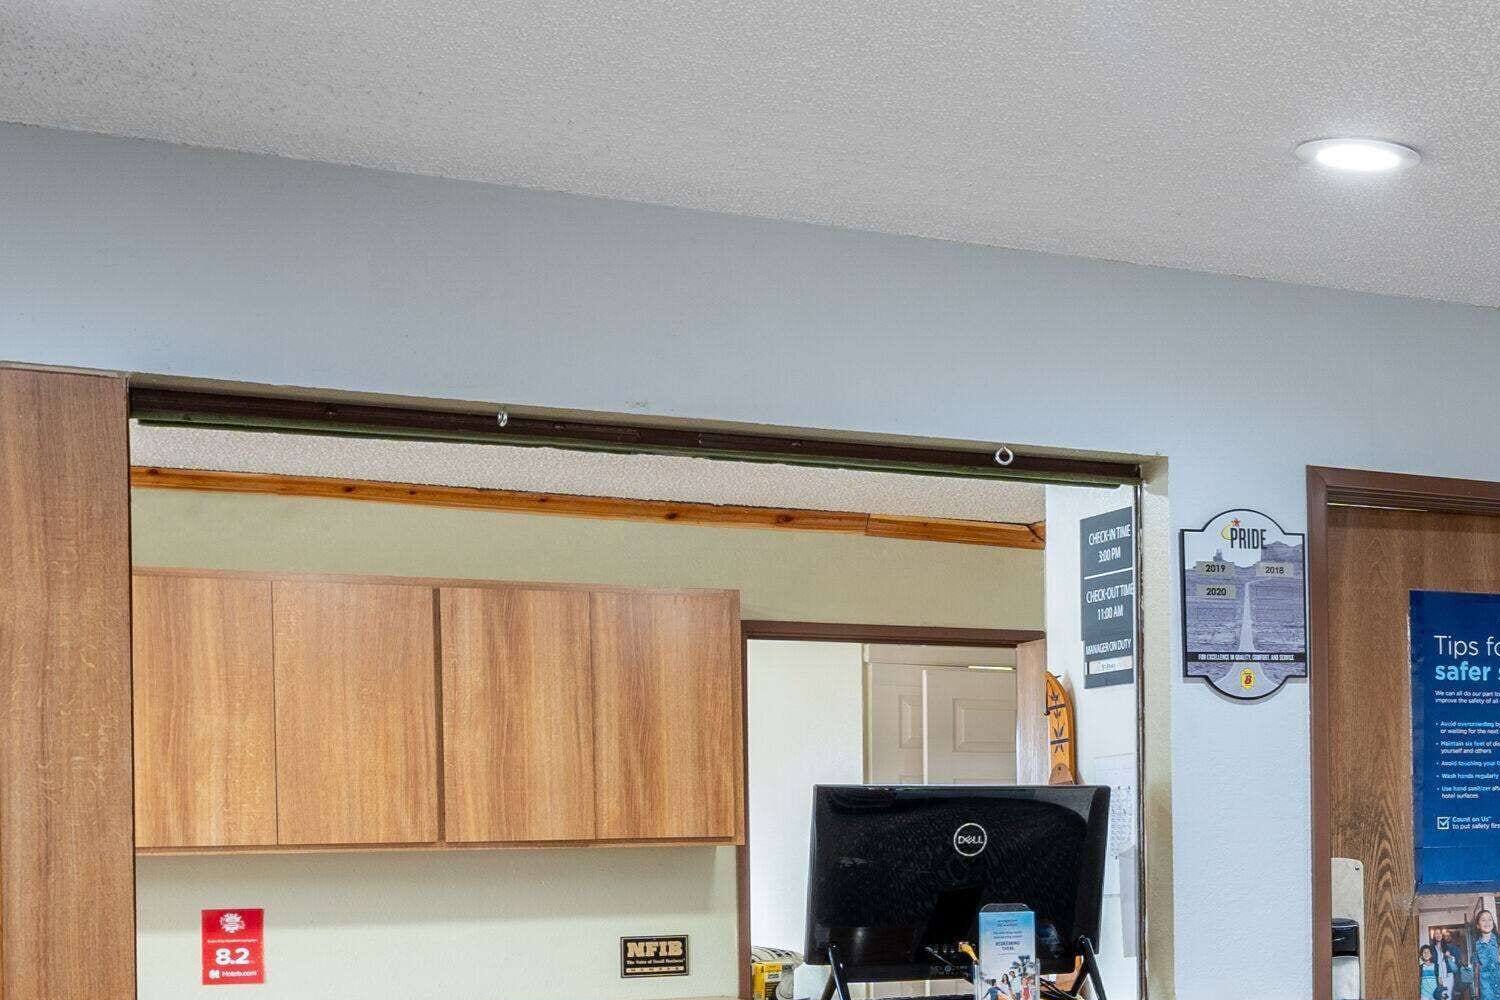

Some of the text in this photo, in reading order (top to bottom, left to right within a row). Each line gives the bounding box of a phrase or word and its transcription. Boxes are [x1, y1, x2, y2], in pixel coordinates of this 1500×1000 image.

[1089, 524, 1131, 545] CHECK-IN TIME
[1230, 528, 1266, 549] PRIDE
[1098, 546, 1121, 563] 3:00 PM
[1206, 564, 1226, 573] 2019
[1266, 566, 1284, 574] 2018
[1086, 582, 1134, 603] CHECK-OUT TIME
[1098, 605, 1123, 620] 11:00 AM
[1086, 642, 1110, 655] MANAGER
[1118, 639, 1131, 650] DUTY
[1434, 635, 1478, 659] Tips
[1435, 661, 1491, 681] safer
[958, 835, 984, 844] DELL
[216, 948, 250, 965] 8.2
[627, 941, 682, 957] NFIB
